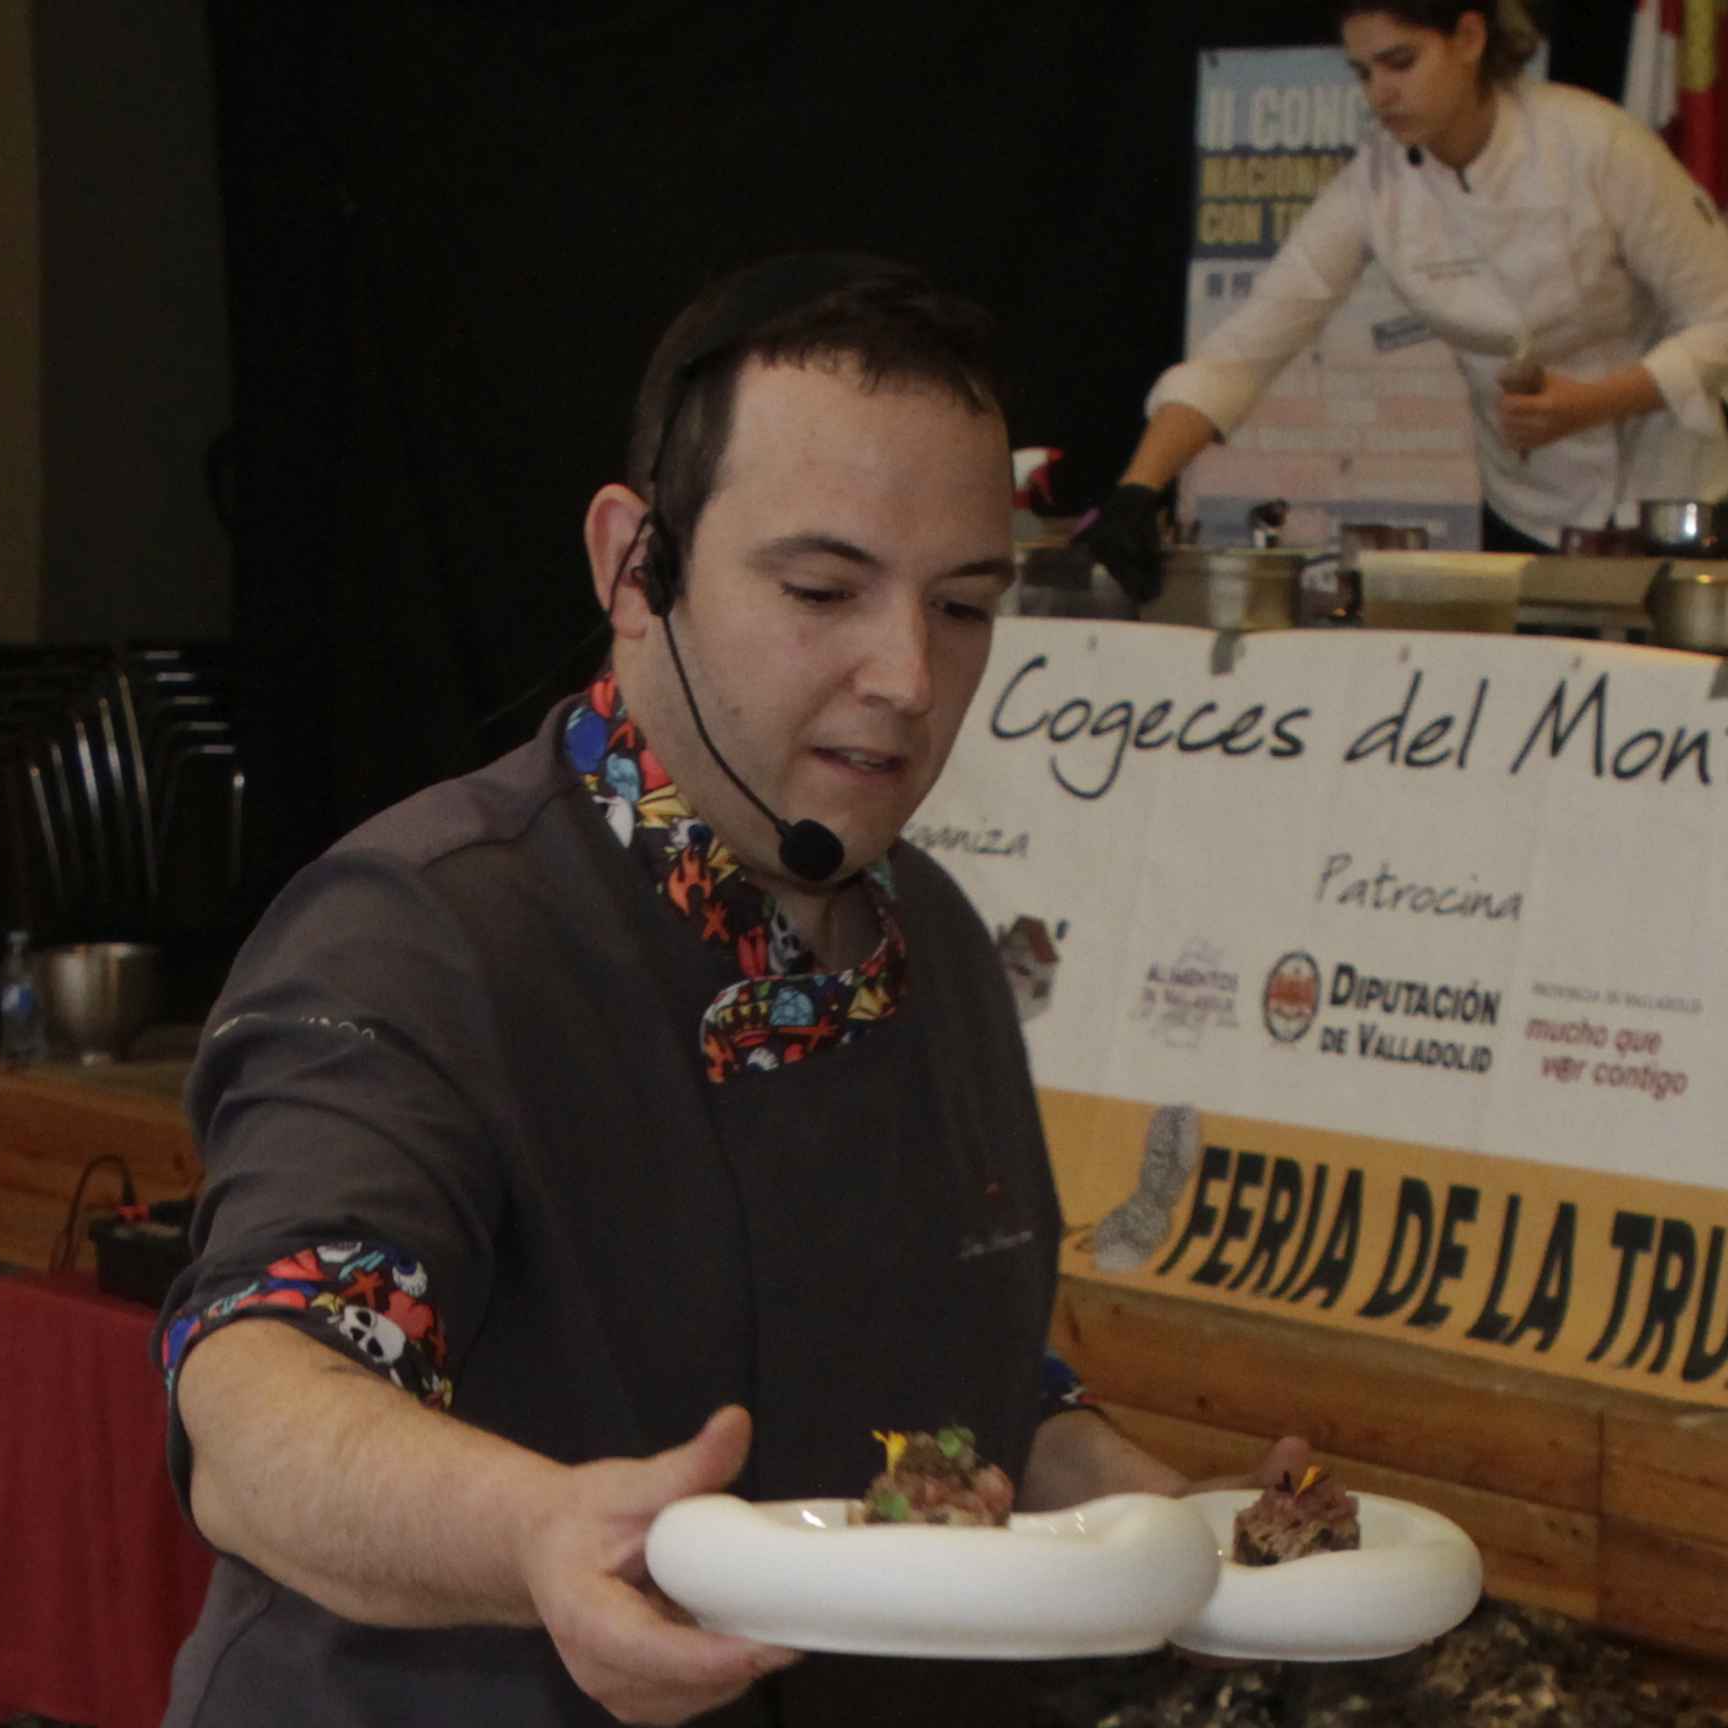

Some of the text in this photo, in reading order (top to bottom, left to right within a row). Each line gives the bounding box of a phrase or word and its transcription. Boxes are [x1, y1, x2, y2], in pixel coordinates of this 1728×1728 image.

[1251, 85, 1358, 150] CON
[990, 655, 1315, 800] Cogeces
[1344, 669, 1490, 770] del
[1314, 851, 1525, 925] Patrocina
[1328, 960, 1503, 1027] DIPUTACIÓN
[1357, 1022, 1493, 1076] VALLADOLID
[1524, 1015, 1664, 1058] mucho que
[1540, 1056, 1690, 1101] ver contigo
[1157, 1145, 1364, 1310] FERIA
[1359, 1177, 1481, 1329] DE
[1470, 1193, 1578, 1354] LA
